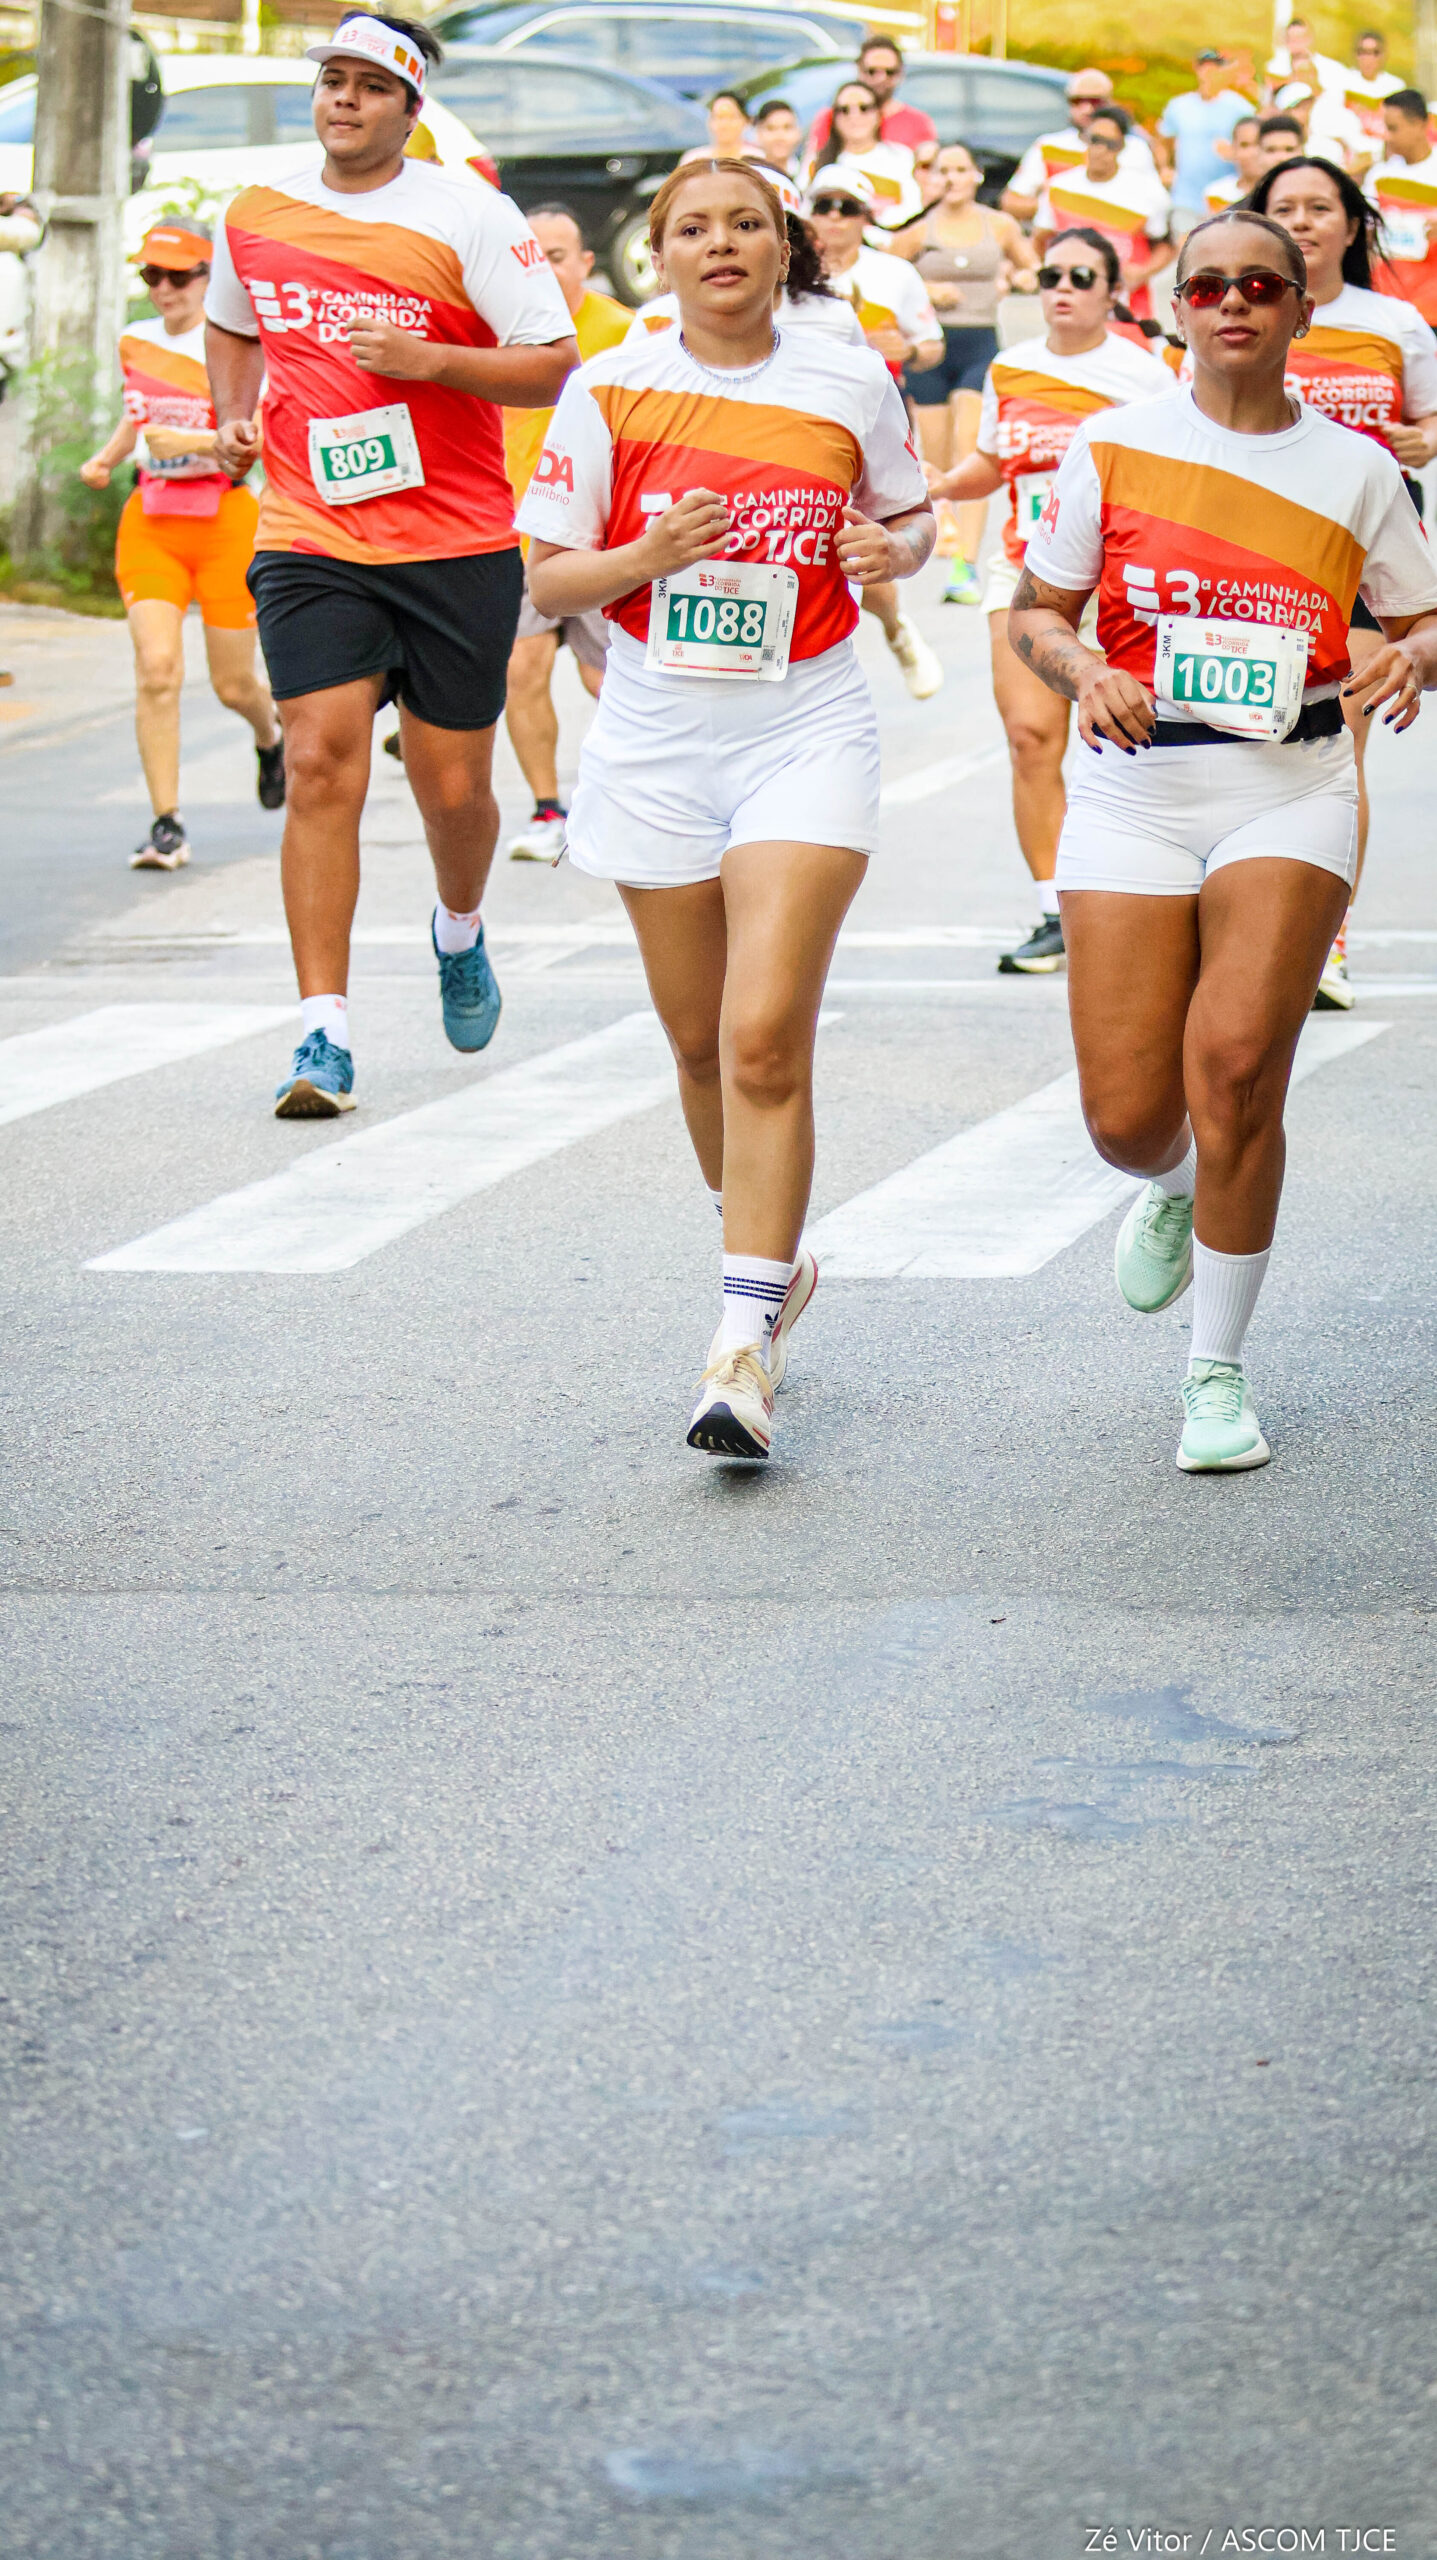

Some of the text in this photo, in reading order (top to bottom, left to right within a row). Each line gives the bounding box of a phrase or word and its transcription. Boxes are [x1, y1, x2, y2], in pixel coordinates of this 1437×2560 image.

[320, 290, 433, 314] CAMINHADA
[1340, 402, 1392, 427] TJCE
[328, 438, 386, 479] 809
[733, 489, 843, 508] CAMINHADA
[724, 530, 831, 566] DO TJCE
[658, 576, 668, 599] 3KM
[723, 586, 739, 595] TJCE
[1216, 579, 1330, 613] CAMINHADA
[672, 597, 765, 645] 1088
[1206, 595, 1324, 634] /CORRIDA
[1162, 635, 1172, 658] 3KM
[1231, 645, 1248, 655] TJCE
[1178, 656, 1274, 704] 1003
